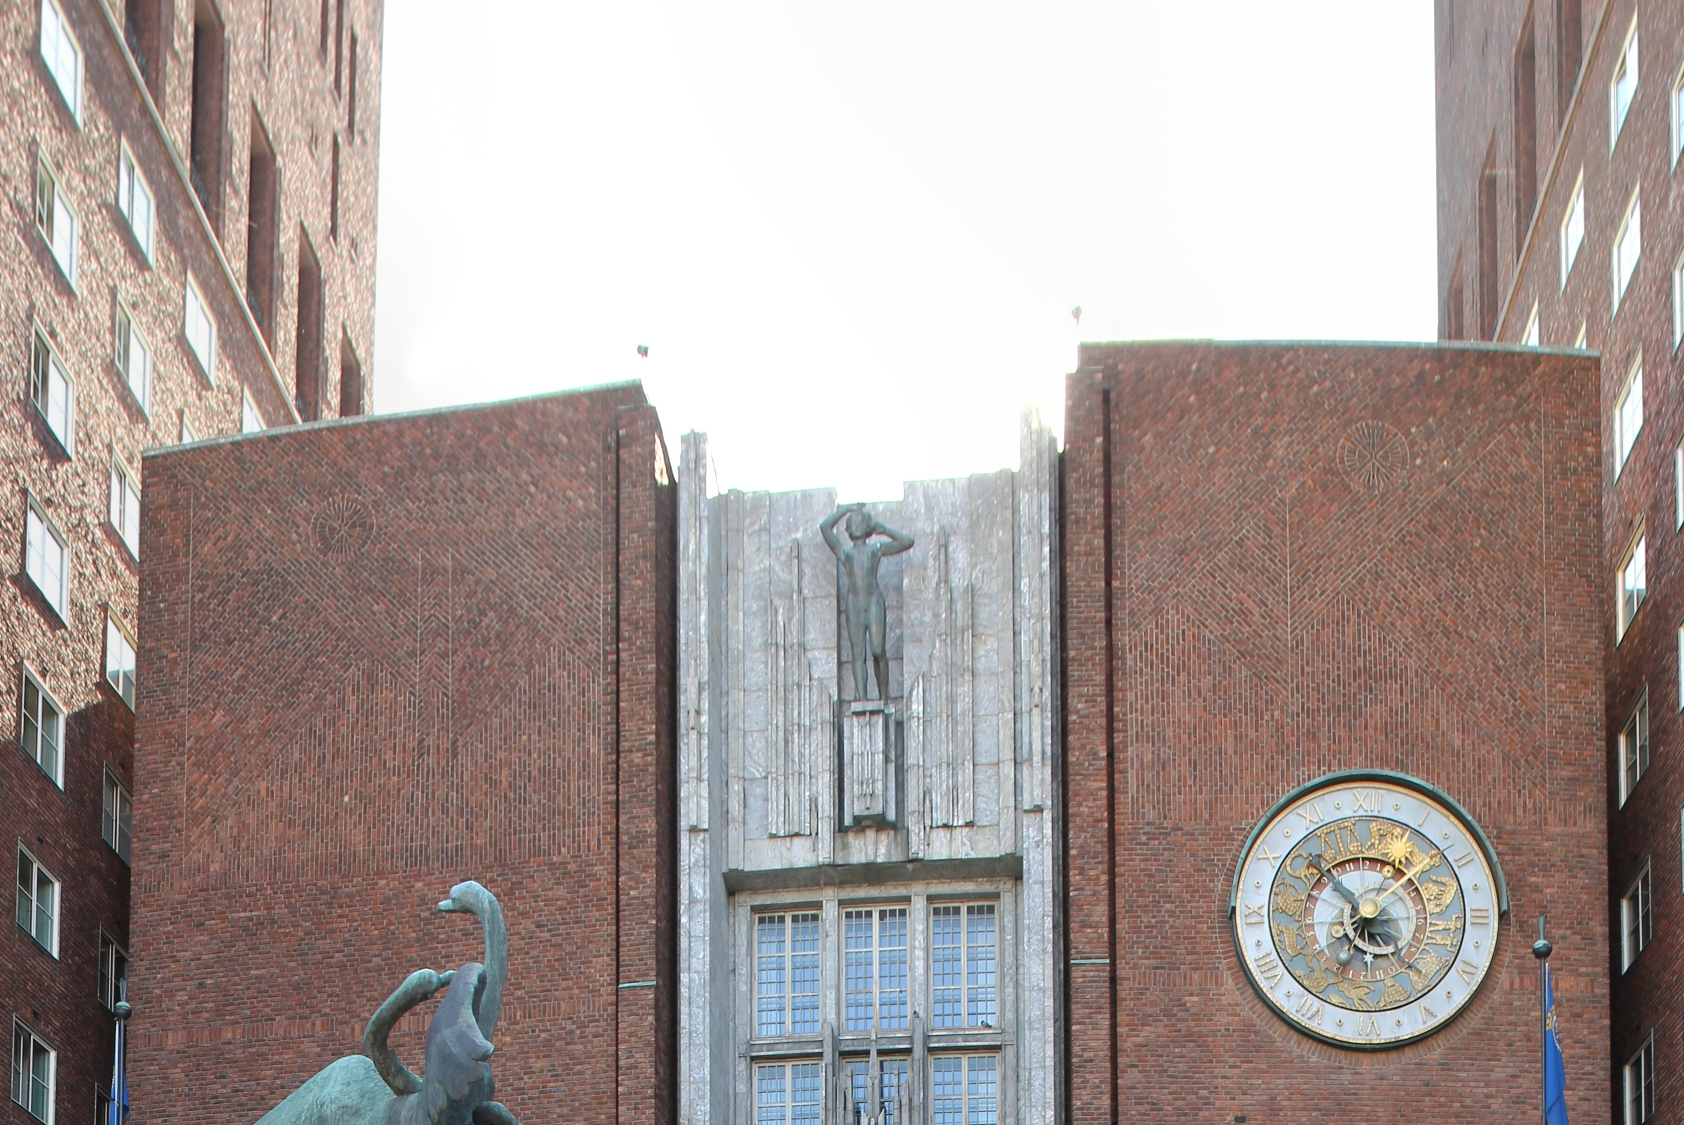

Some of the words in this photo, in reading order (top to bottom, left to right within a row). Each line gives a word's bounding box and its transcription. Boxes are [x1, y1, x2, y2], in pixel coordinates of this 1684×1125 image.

[1353, 790, 1383, 812] XII
[1297, 802, 1324, 829] XI
[1418, 809, 1432, 826] I
[1257, 846, 1281, 867] X
[1453, 851, 1475, 868] II
[1244, 902, 1264, 925] IX
[1470, 907, 1489, 925] III
[1254, 951, 1283, 989] VIII
[1456, 958, 1478, 984] IV
[1296, 996, 1323, 1025] VII
[1420, 1002, 1437, 1024] V
[1358, 1015, 1380, 1036] VI
